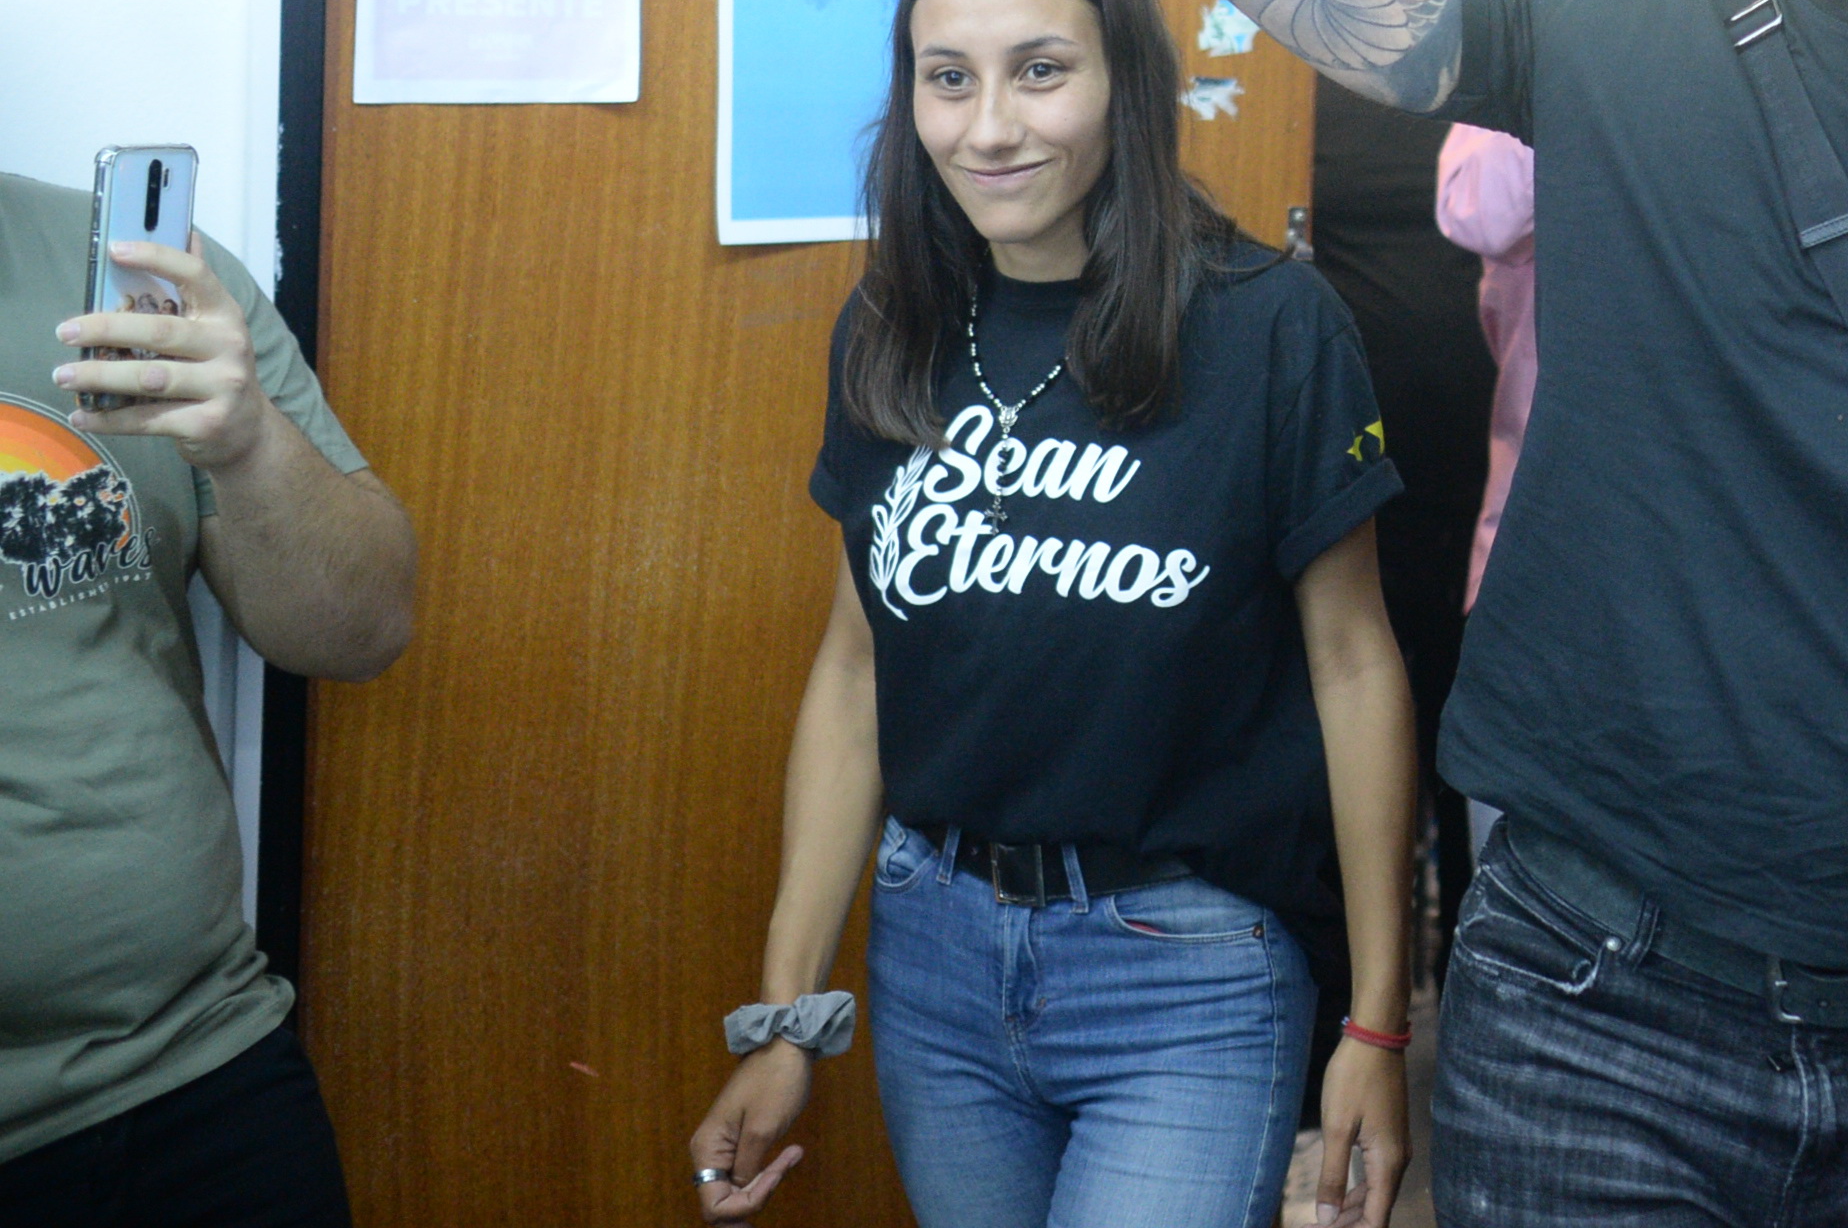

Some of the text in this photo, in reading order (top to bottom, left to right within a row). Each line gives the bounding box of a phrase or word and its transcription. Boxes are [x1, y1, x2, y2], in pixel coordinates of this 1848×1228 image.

[922, 404, 1141, 503] Sean
[23, 526, 157, 599] waves
[894, 503, 1210, 608] Eternos
